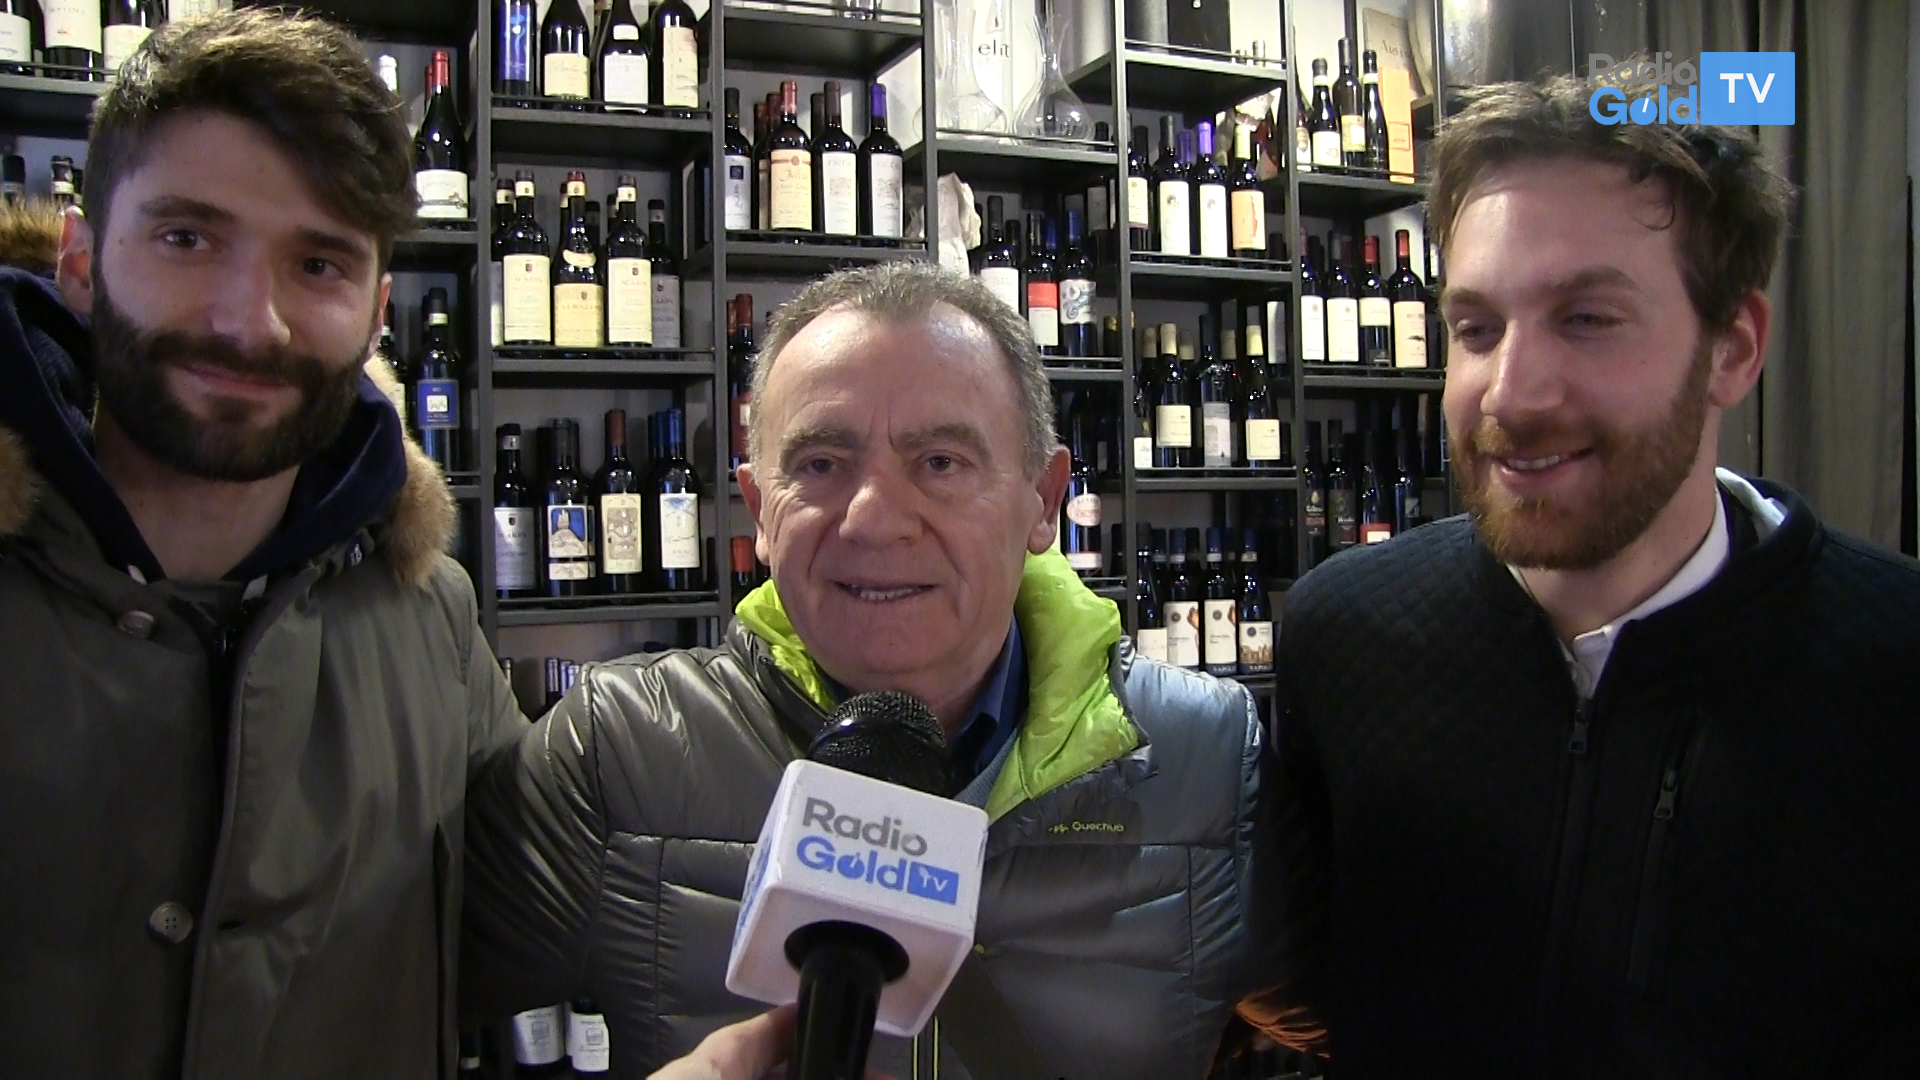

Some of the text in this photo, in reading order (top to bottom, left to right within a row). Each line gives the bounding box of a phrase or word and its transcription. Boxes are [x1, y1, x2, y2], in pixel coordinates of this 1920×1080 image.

[978, 38, 1010, 57] elit
[802, 797, 928, 857] Radio
[1071, 821, 1125, 833] Quechua
[796, 835, 908, 892] Gold
